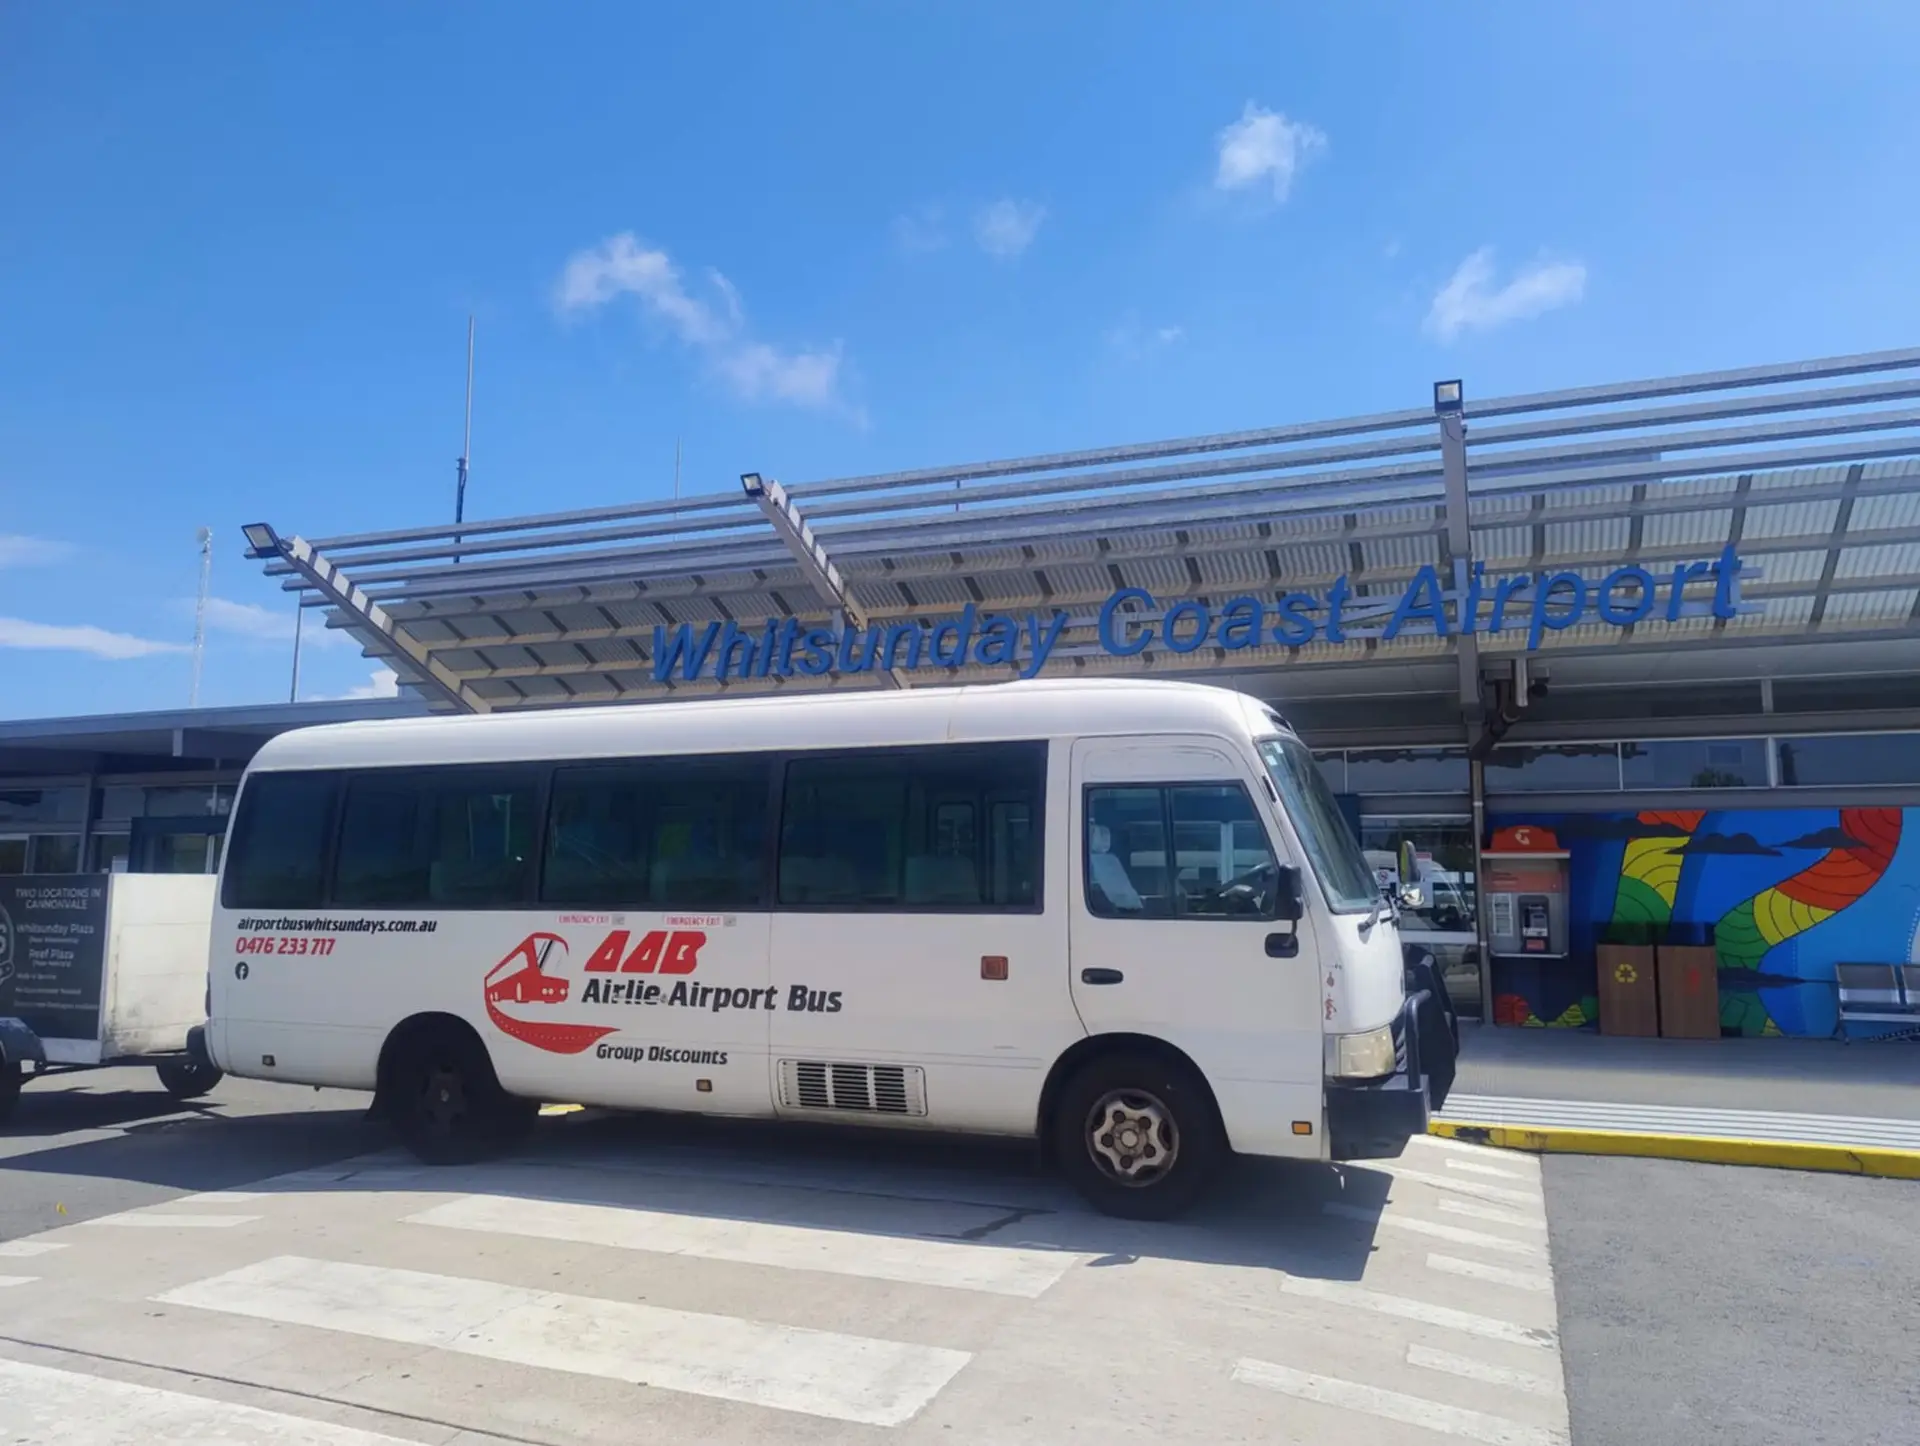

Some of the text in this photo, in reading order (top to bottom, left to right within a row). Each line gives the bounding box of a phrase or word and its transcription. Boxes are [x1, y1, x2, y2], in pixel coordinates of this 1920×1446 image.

[650, 542, 1743, 680] Whitsunday Coast Airport
[15, 888, 101, 898] TWO LOCATIONS IN
[25, 899, 88, 910] CANNONVALE
[70, 924, 95, 934] Plaza
[237, 916, 437, 934] airportbuswhitsundays.com.au
[236, 937, 336, 955] 0476 233 717
[584, 930, 707, 974] AAB
[581, 977, 843, 1012] Airlie Airport Bus
[596, 1043, 728, 1065] Group Discounts
